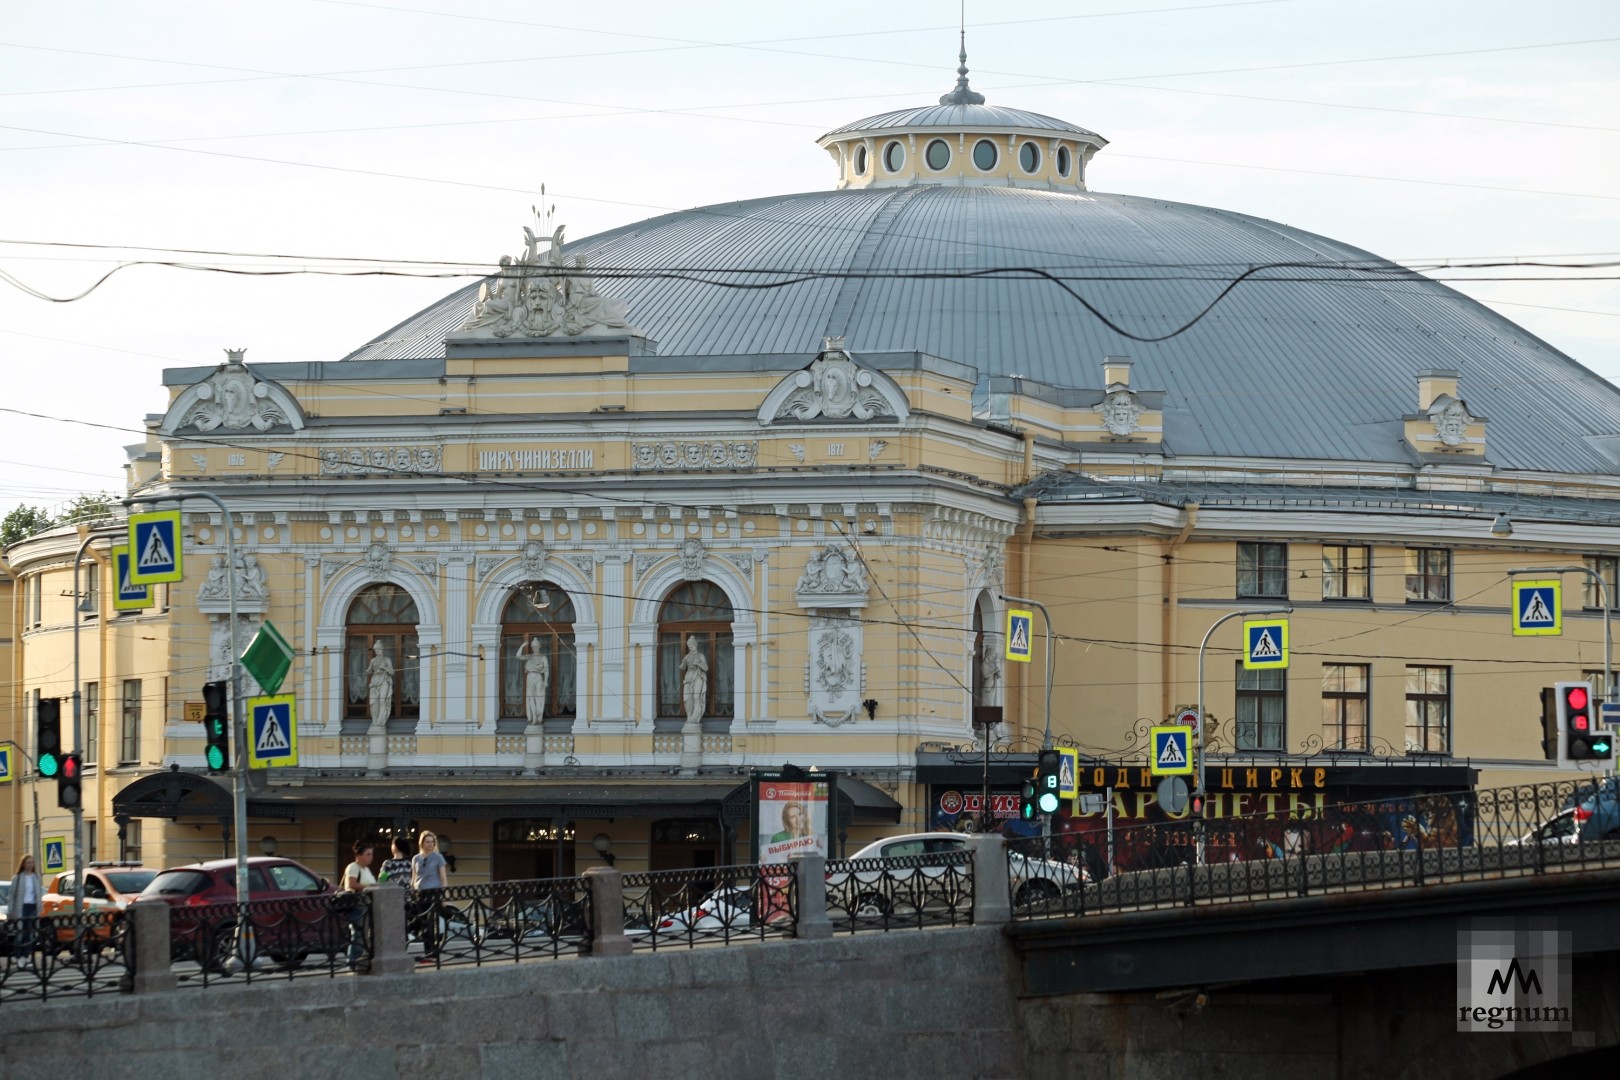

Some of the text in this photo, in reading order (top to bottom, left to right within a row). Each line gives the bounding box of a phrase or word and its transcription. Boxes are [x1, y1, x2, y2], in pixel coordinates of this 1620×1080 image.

[827, 443, 845, 456] 1877
[228, 454, 245, 466] 1876
[479, 449, 594, 471] ЦИРК ЧИНИЗЕЛЛИ
[191, 711, 201, 719] 15
[768, 838, 814, 855] ВЫБИРАЮ
